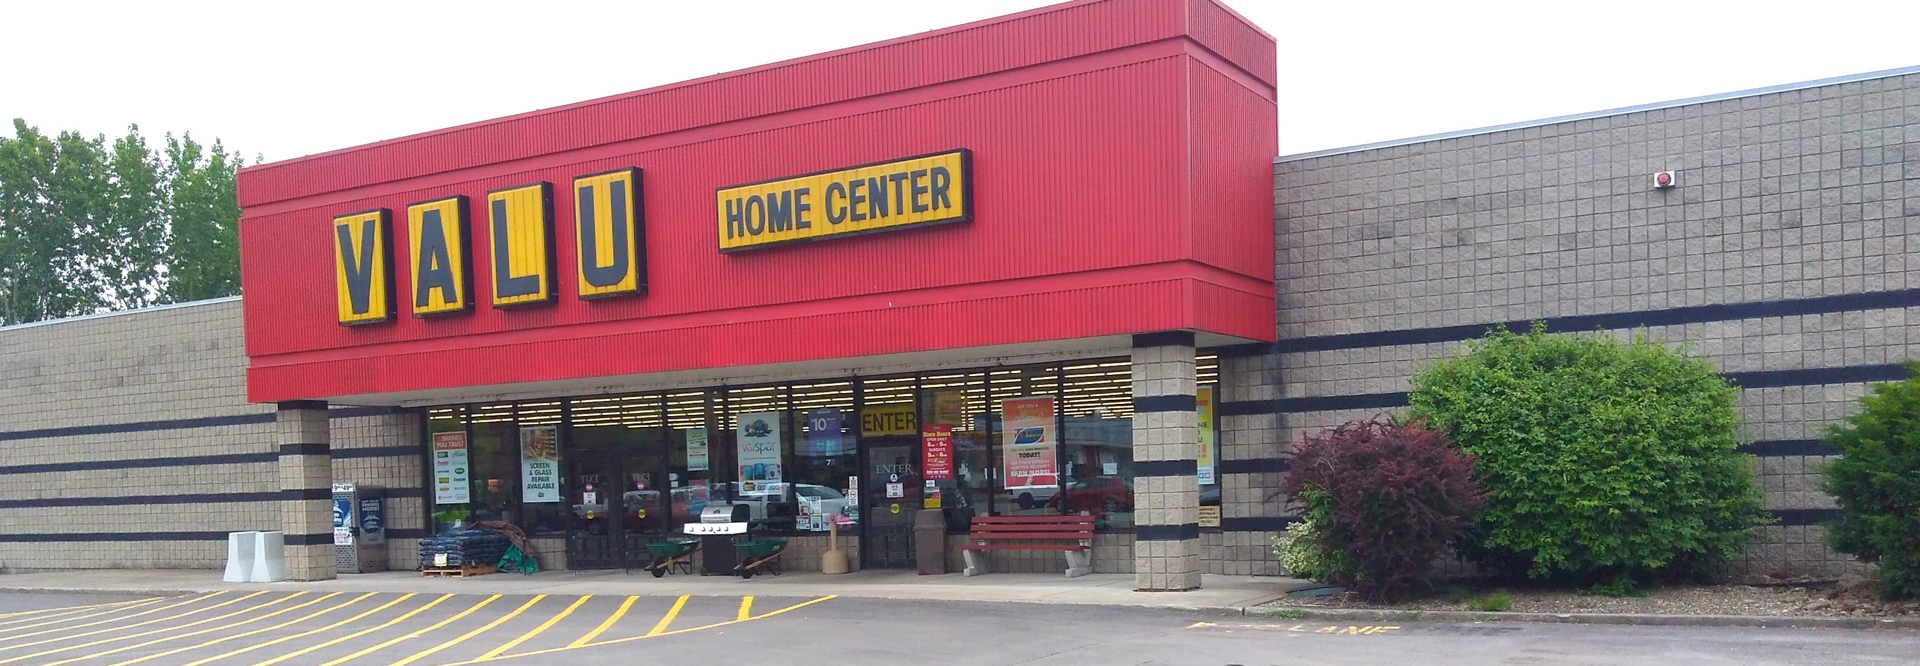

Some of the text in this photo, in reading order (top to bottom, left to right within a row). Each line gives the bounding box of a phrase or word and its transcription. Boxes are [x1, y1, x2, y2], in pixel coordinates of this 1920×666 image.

[725, 166, 952, 240] HOME CENTER
[336, 179, 631, 314] VALU
[862, 411, 916, 432] ENTER
[441, 434, 463, 442] BRANDS
[742, 441, 776, 455] valspar
[876, 463, 912, 474] ENTER
